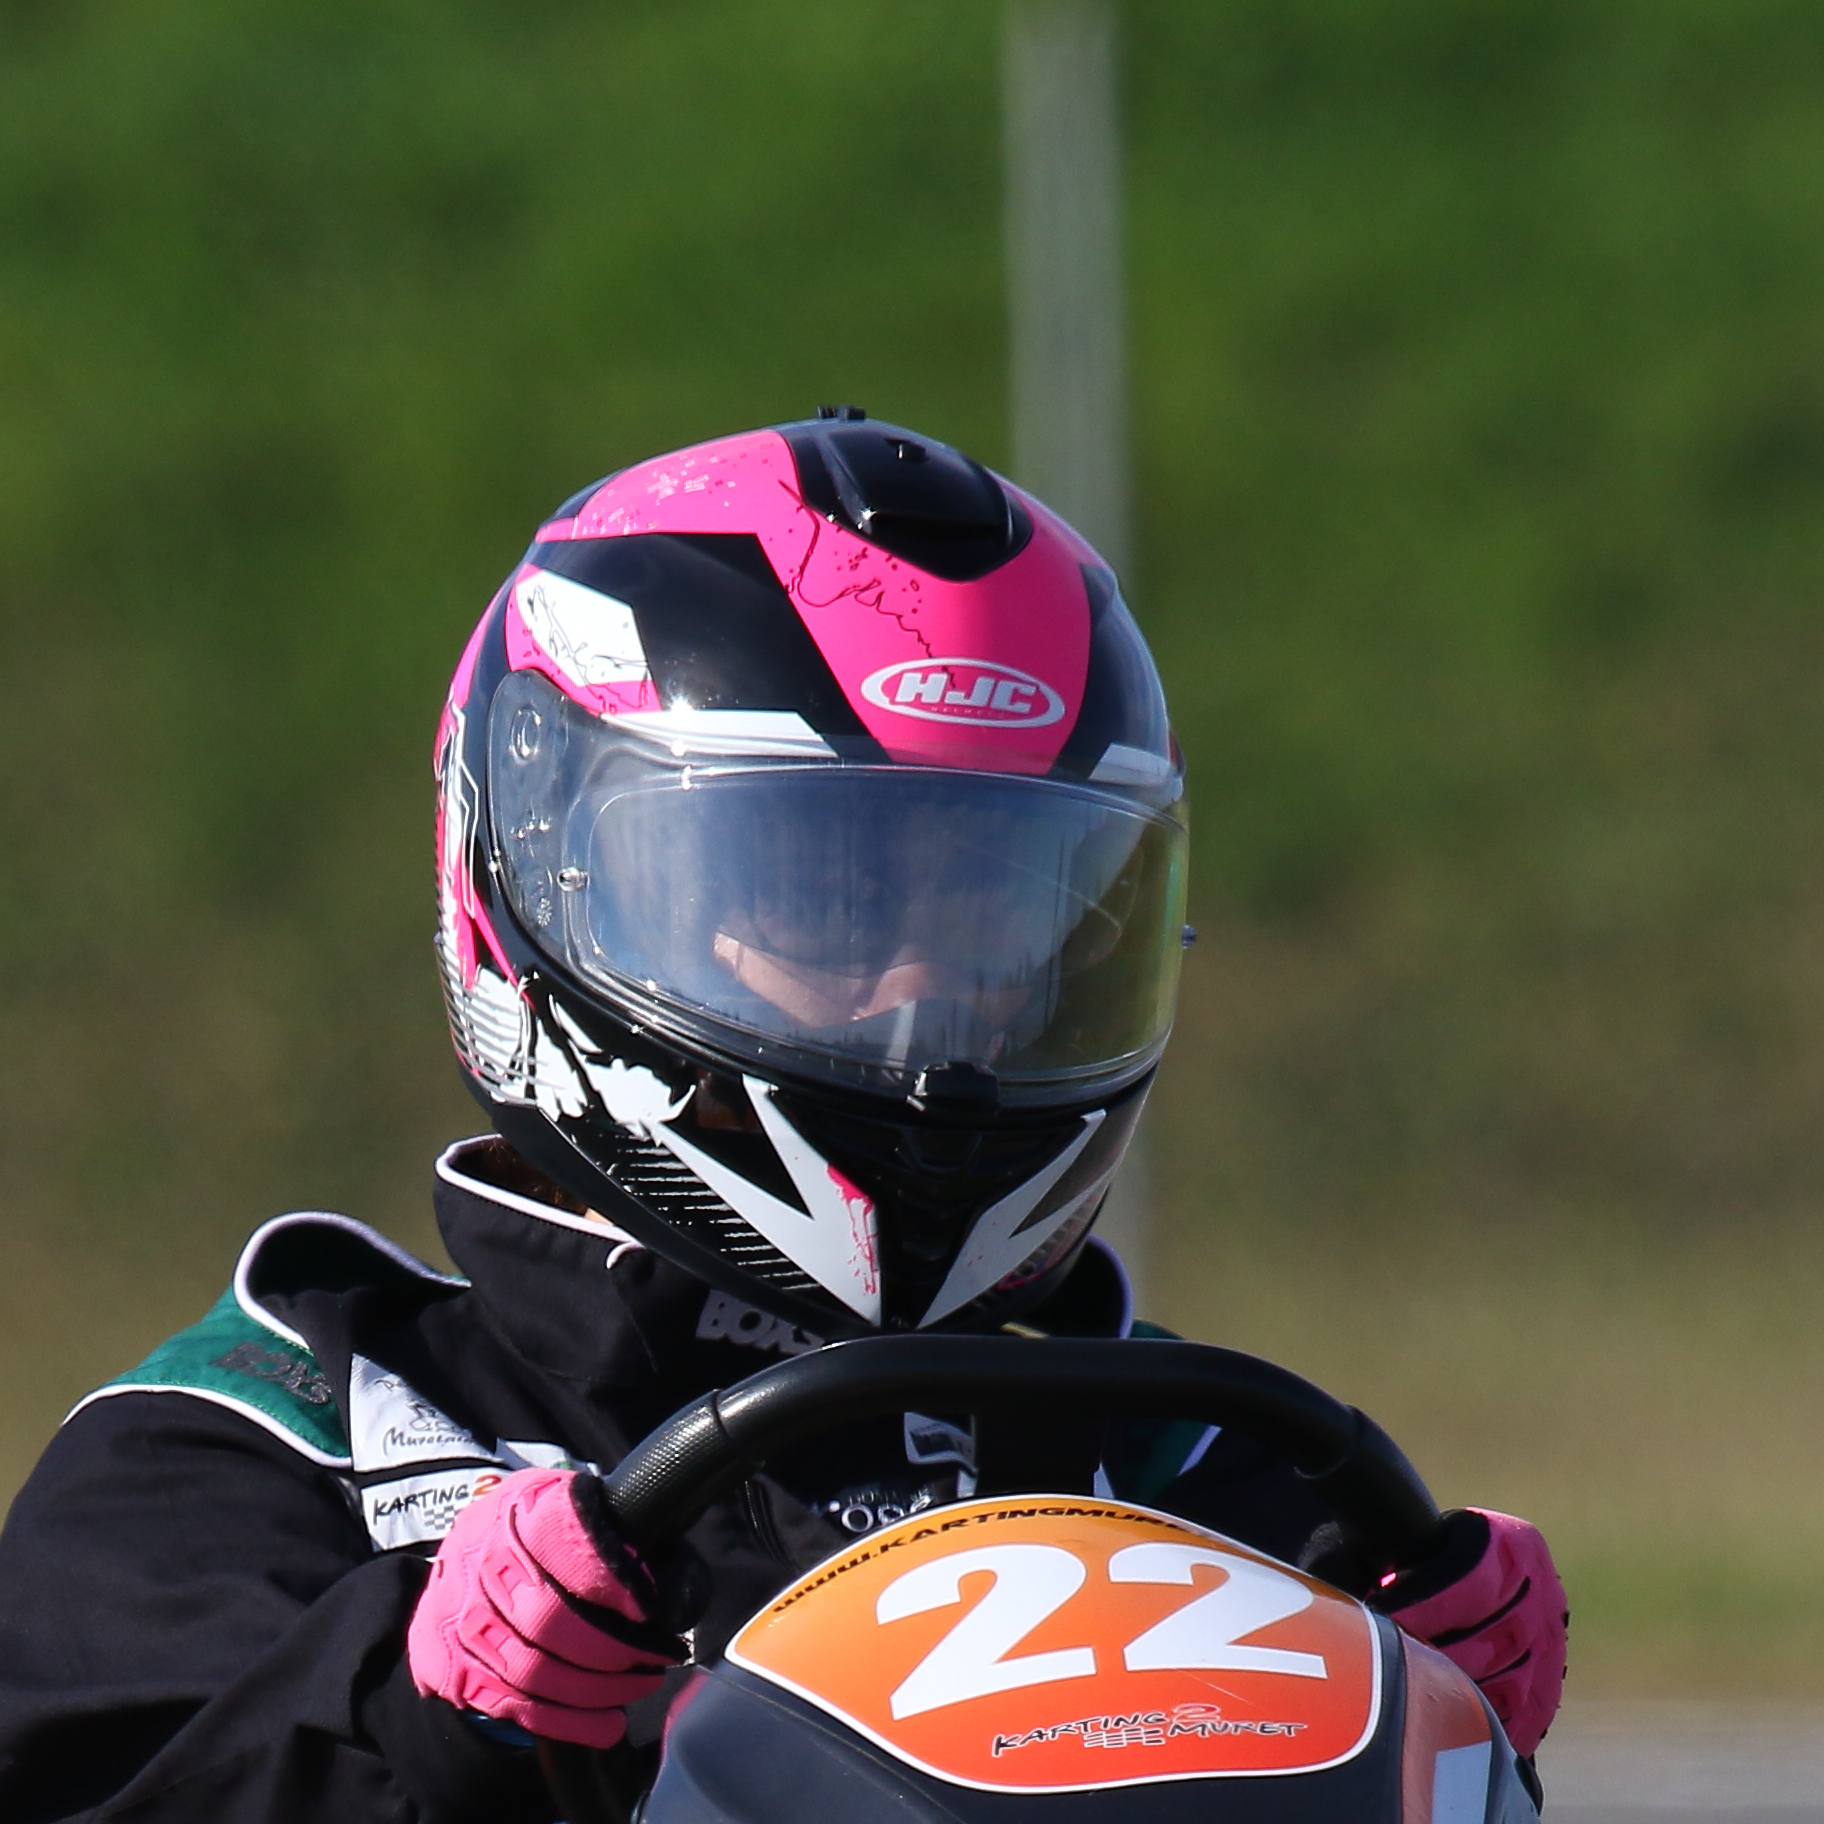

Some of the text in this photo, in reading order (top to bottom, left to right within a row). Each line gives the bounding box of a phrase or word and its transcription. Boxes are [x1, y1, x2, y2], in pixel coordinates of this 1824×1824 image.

[894, 671, 1038, 714] HJC
[373, 1473, 502, 1526] KARTING 2
[876, 1541, 1329, 1720] 22
[991, 1711, 1170, 1757] KARTING
[1167, 1721, 1310, 1738] MURET
